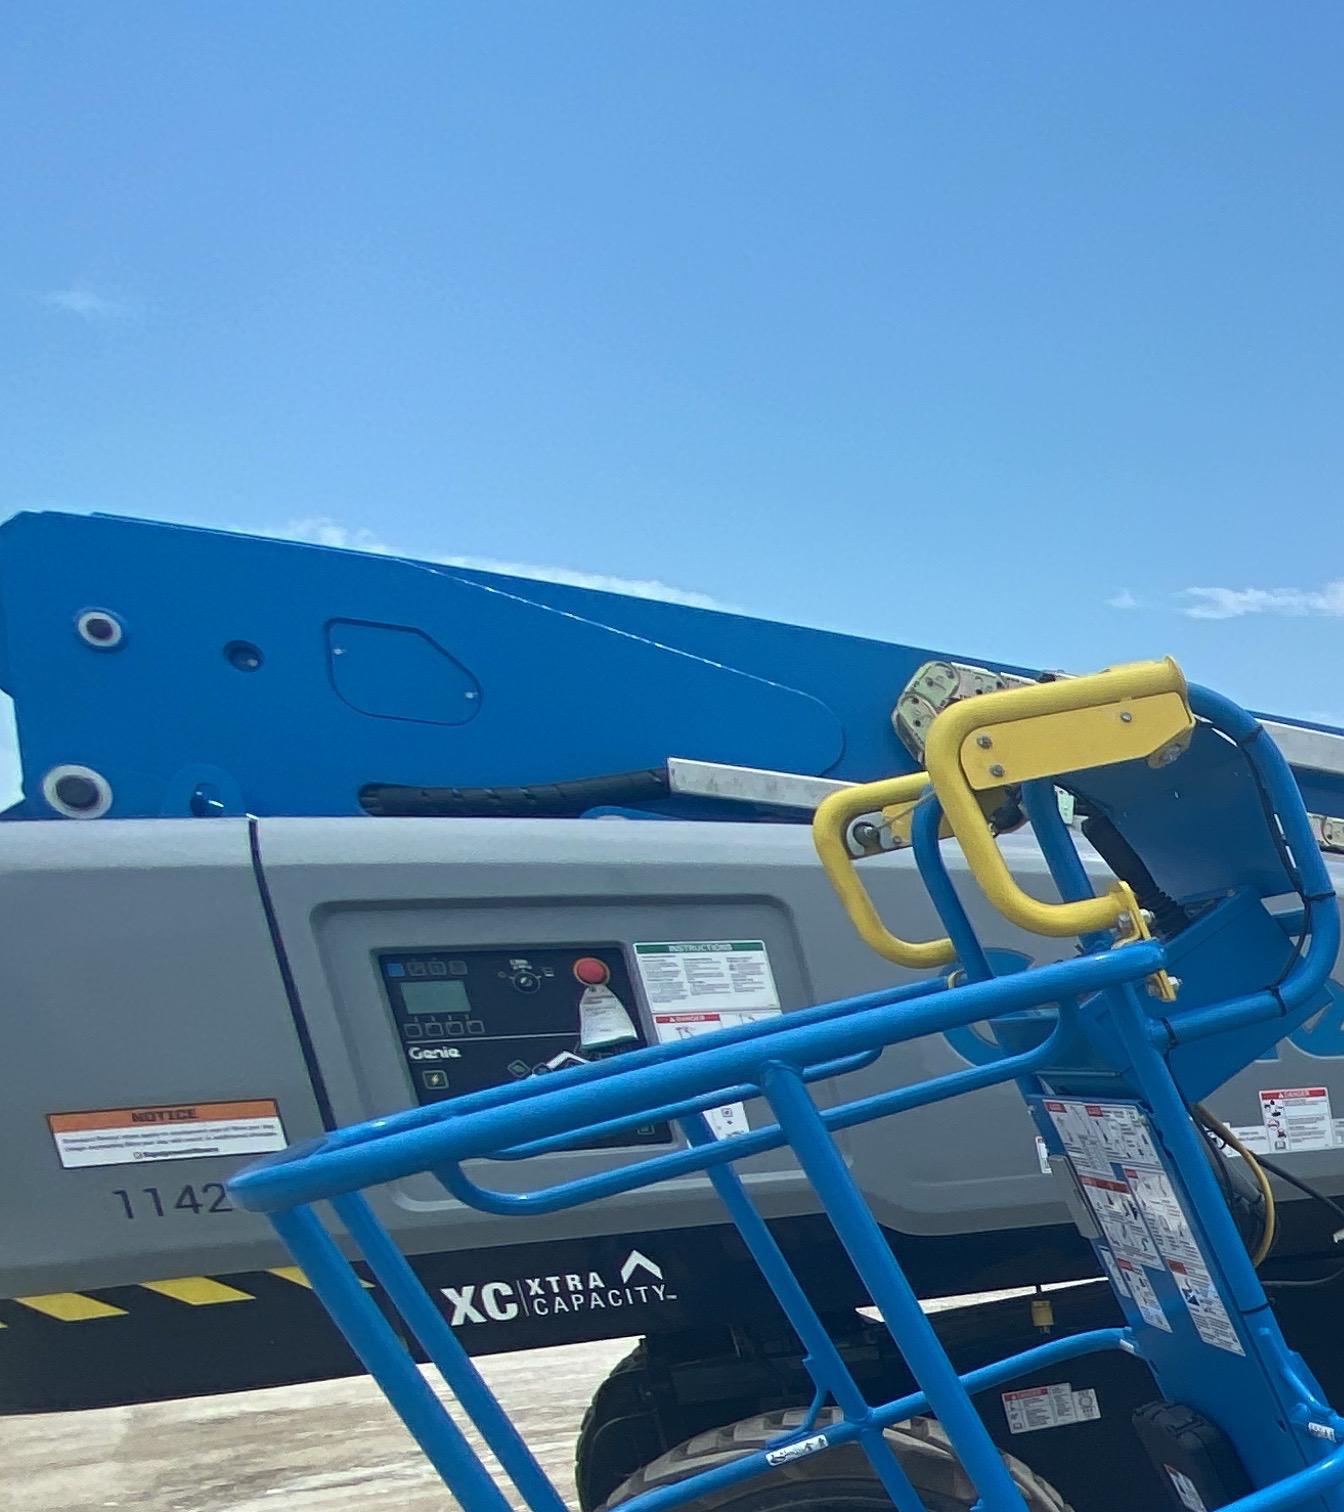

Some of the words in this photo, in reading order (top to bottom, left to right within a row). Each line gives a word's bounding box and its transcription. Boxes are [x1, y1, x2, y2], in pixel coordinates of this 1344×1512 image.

[408, 1046, 461, 1060] Genie
[131, 1108, 197, 1122] NOTICE
[112, 1183, 233, 1219] 1142
[525, 1271, 605, 1296] XTRA
[440, 1281, 519, 1327] XC
[533, 1284, 666, 1317] CAPACITY
